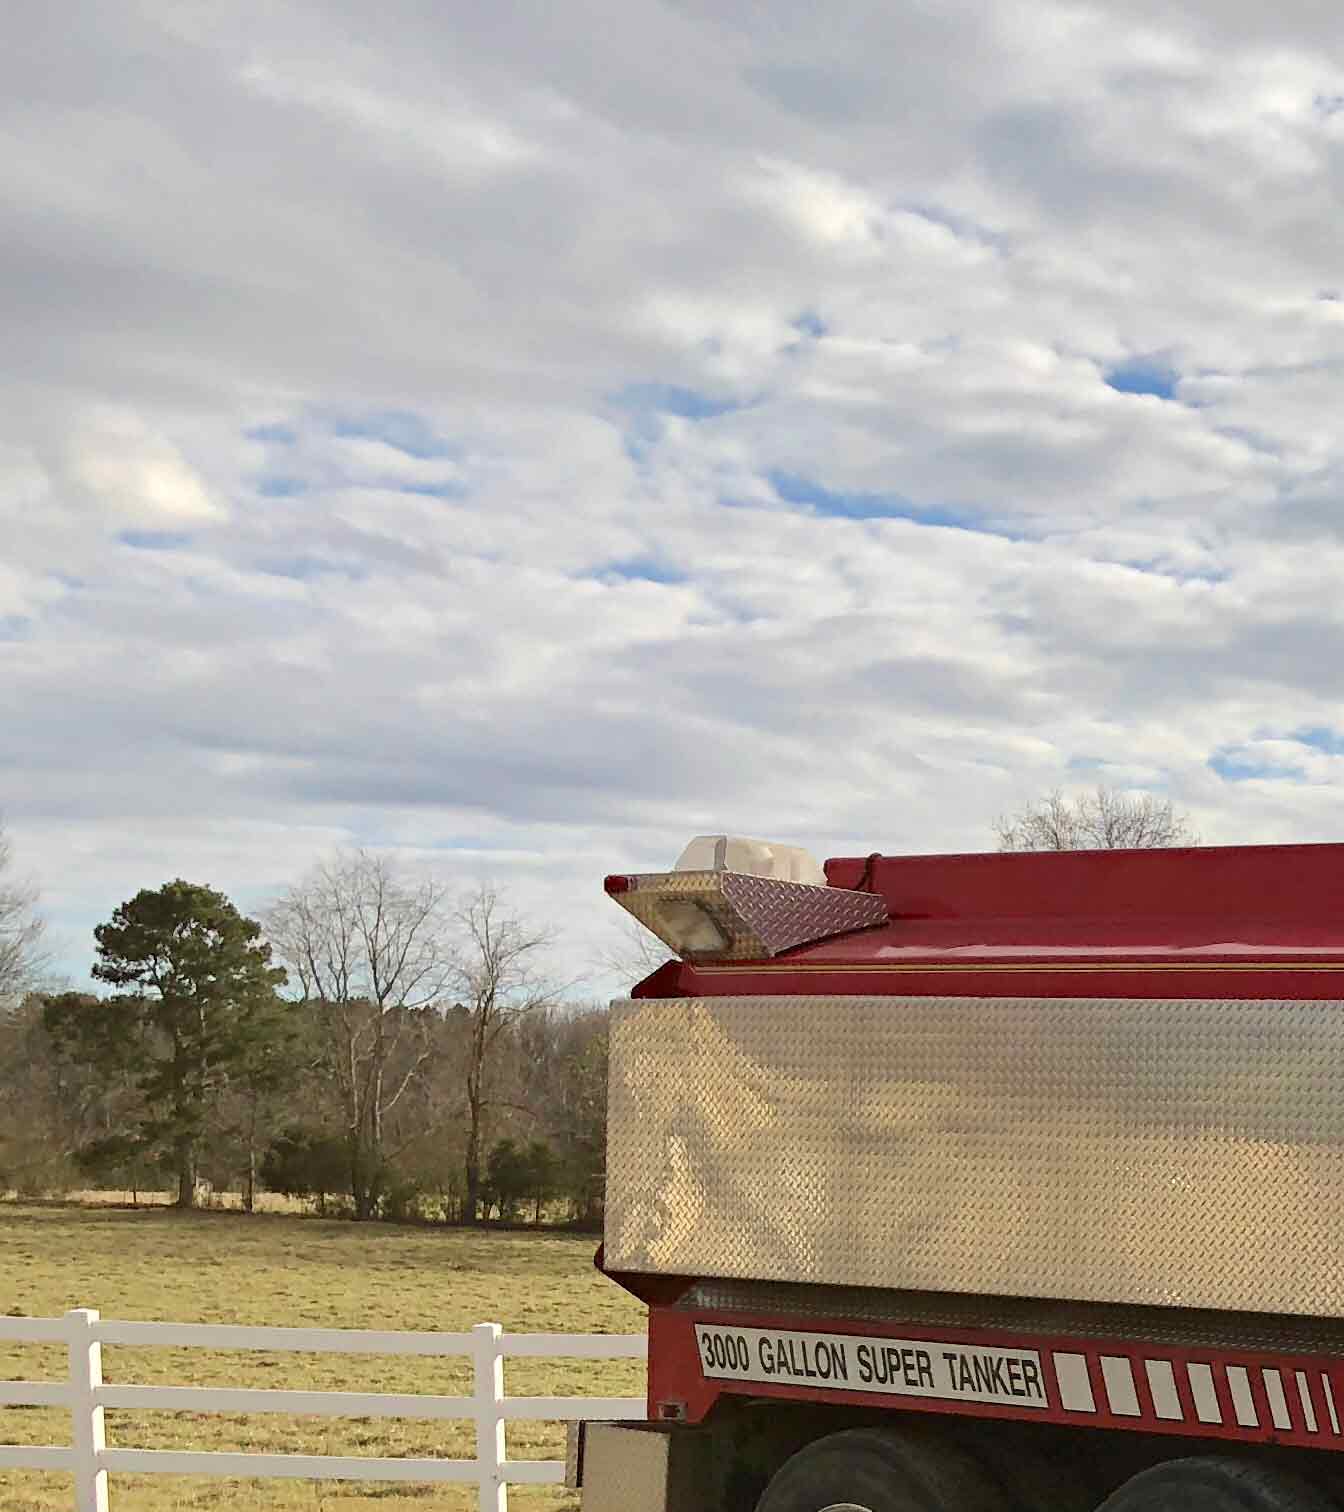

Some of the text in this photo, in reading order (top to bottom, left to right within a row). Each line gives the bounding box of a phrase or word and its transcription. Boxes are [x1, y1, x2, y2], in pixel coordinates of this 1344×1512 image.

[702, 1332, 1042, 1398] 3000 GALLON SUPER TANKER
